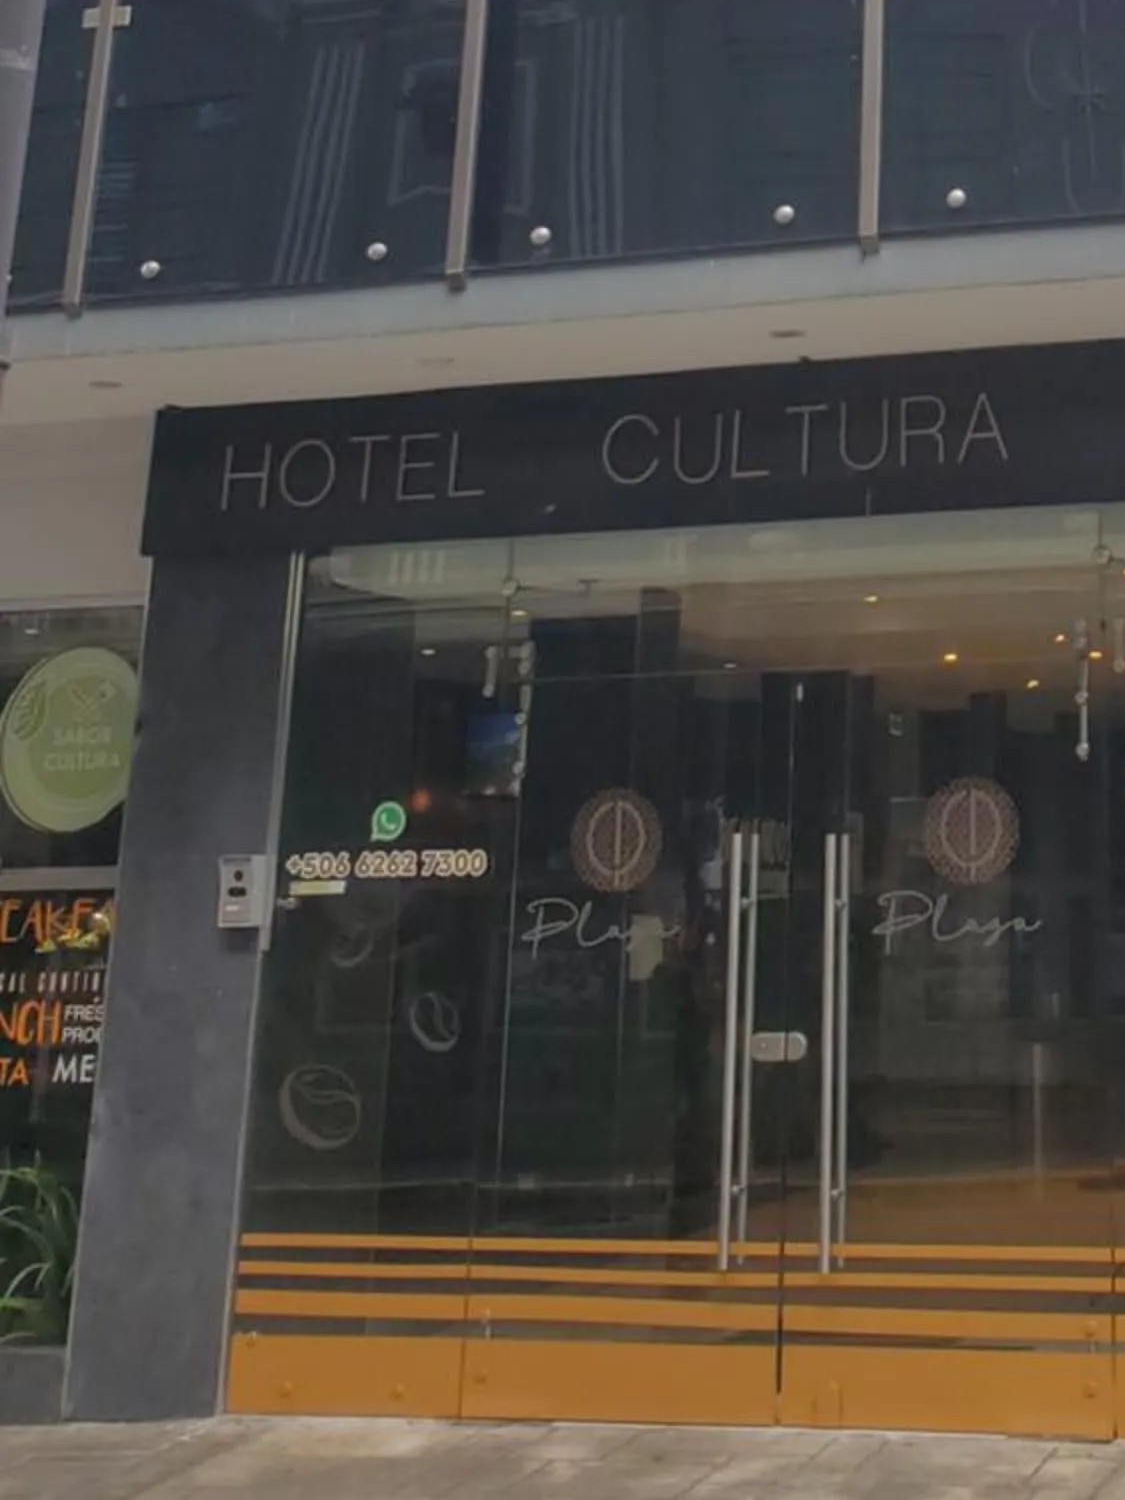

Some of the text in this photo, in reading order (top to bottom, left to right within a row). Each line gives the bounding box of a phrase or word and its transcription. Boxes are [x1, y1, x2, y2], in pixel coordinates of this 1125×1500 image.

[220, 430, 485, 512] HOTEL
[601, 392, 1010, 486] CULTURA
[354, 849, 418, 878] 6262
[420, 848, 488, 877] 7300
[61, 1026, 101, 1045] PRO
